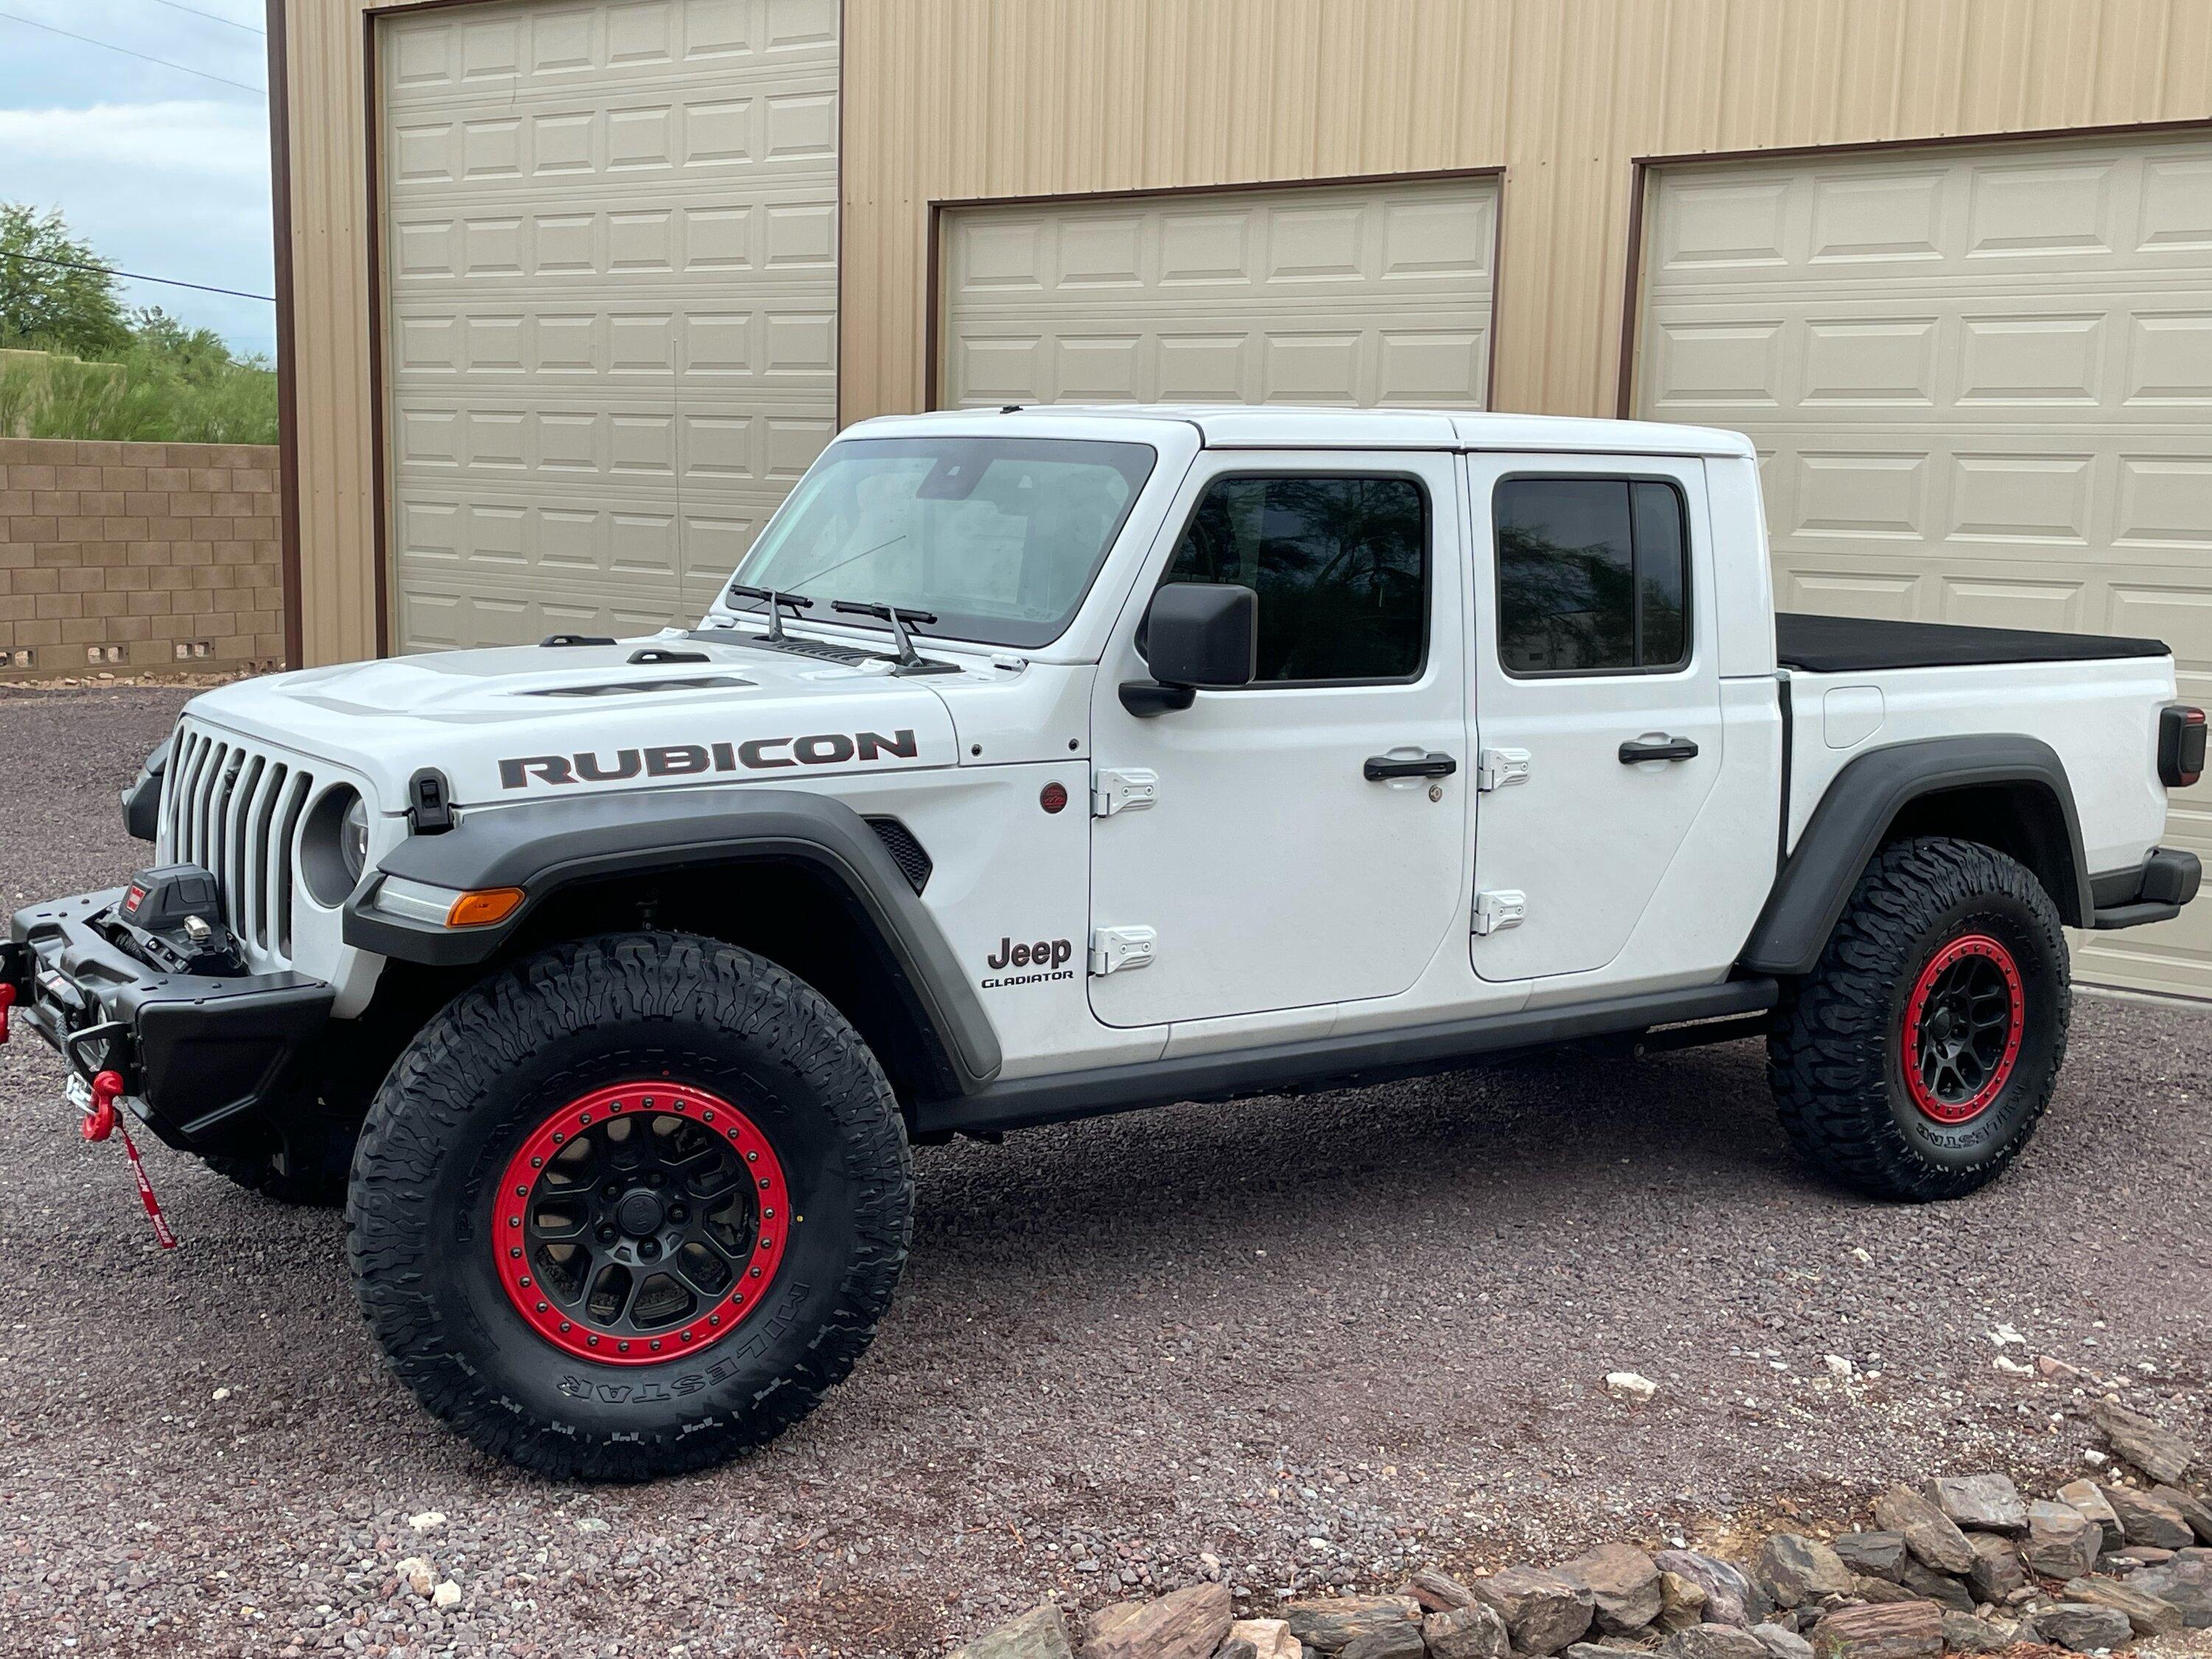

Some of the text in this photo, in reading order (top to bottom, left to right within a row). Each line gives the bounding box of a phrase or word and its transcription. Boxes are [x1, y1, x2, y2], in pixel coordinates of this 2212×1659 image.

[498, 729, 918, 790] RUBICON
[987, 936, 1071, 970] Jeep
[981, 970, 1074, 989] GLADIATOR
[557, 1281, 810, 1404] MILESTAR
